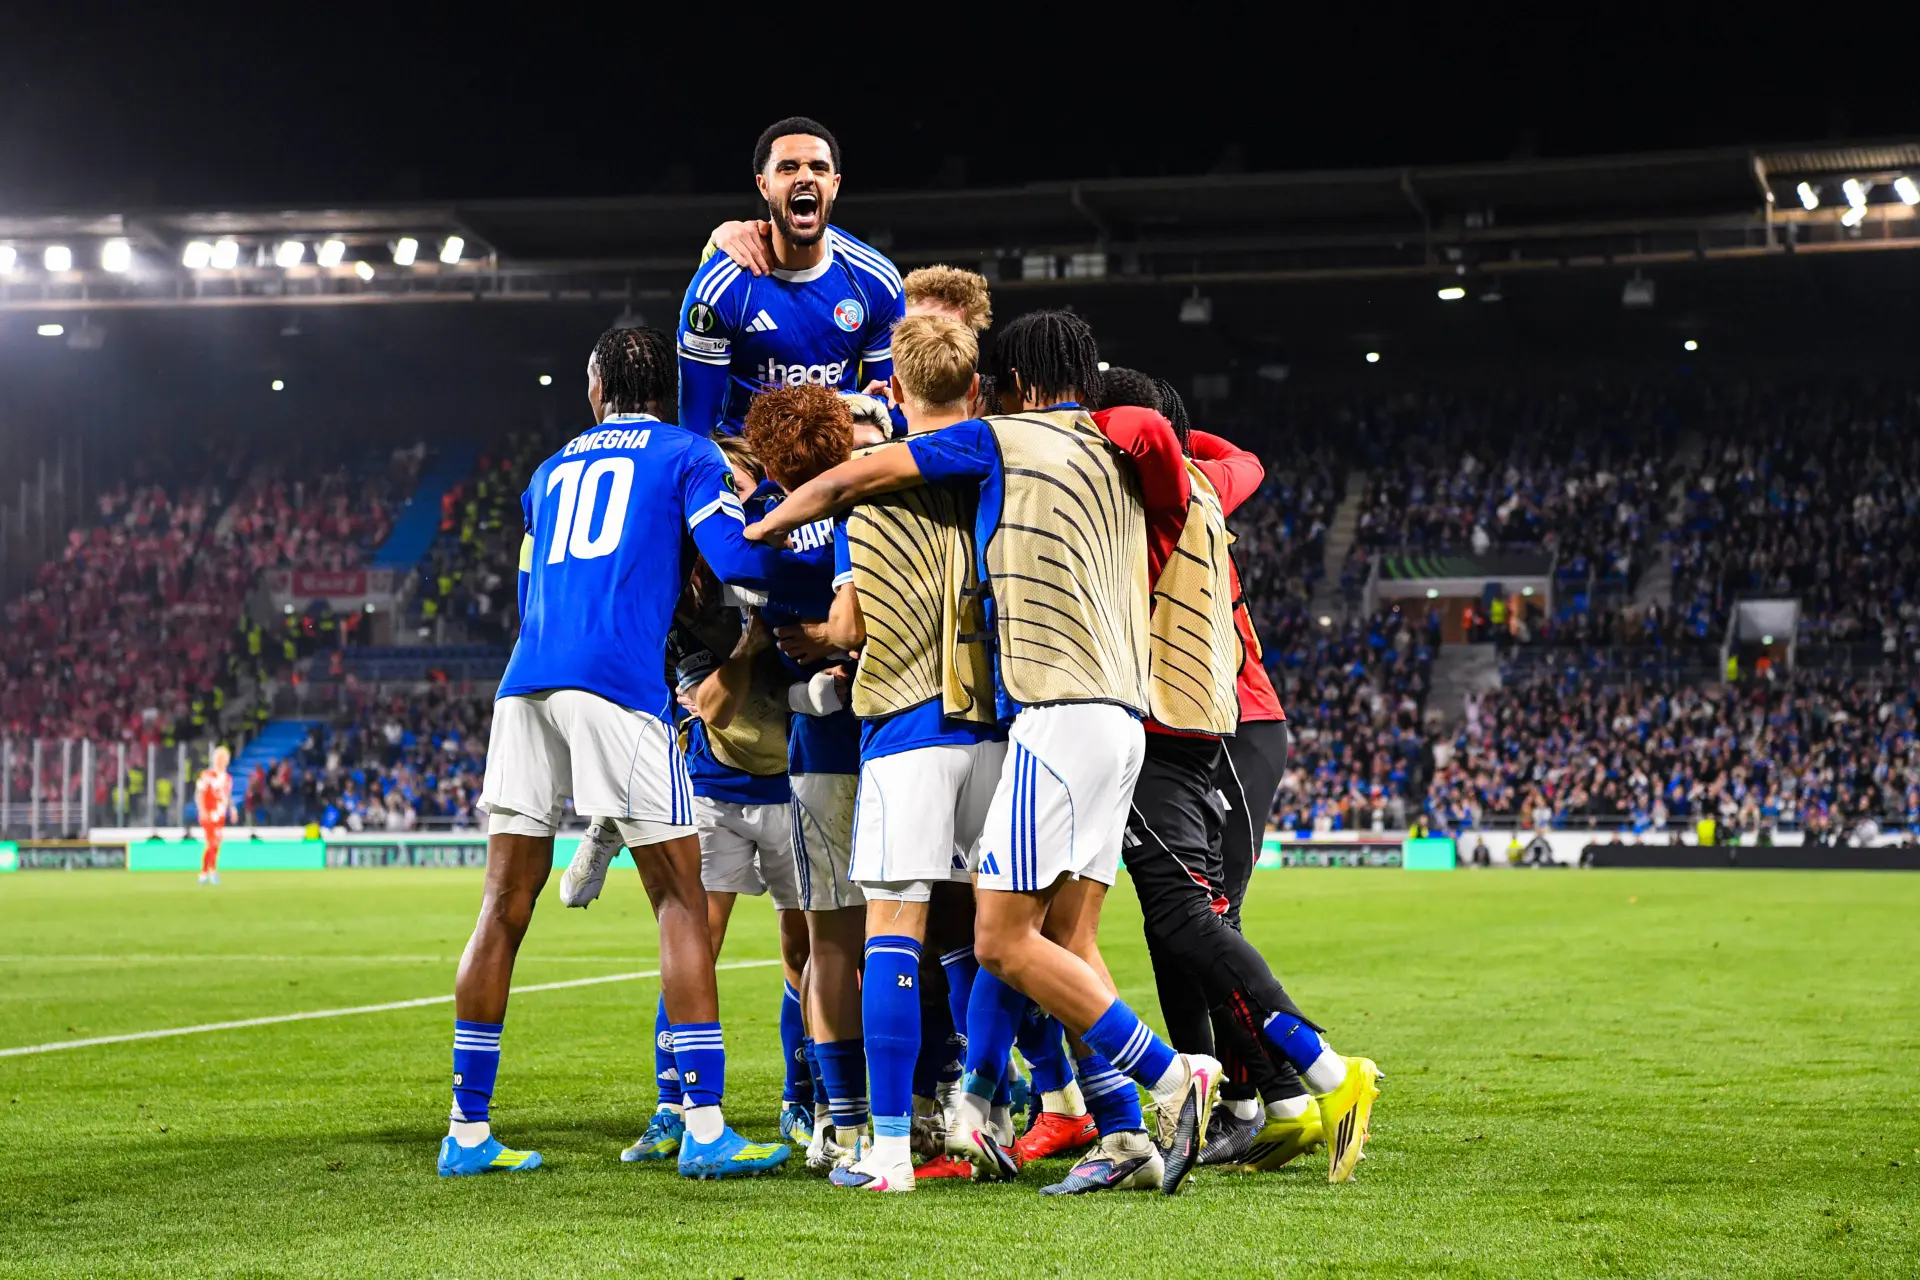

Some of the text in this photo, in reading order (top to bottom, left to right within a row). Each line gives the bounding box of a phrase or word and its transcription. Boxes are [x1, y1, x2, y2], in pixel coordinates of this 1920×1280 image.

[563, 429, 651, 457] EMEGHA
[546, 456, 635, 565] 10
[789, 516, 834, 554] BAR
[898, 974, 913, 988] 24
[684, 1071, 697, 1084] 10
